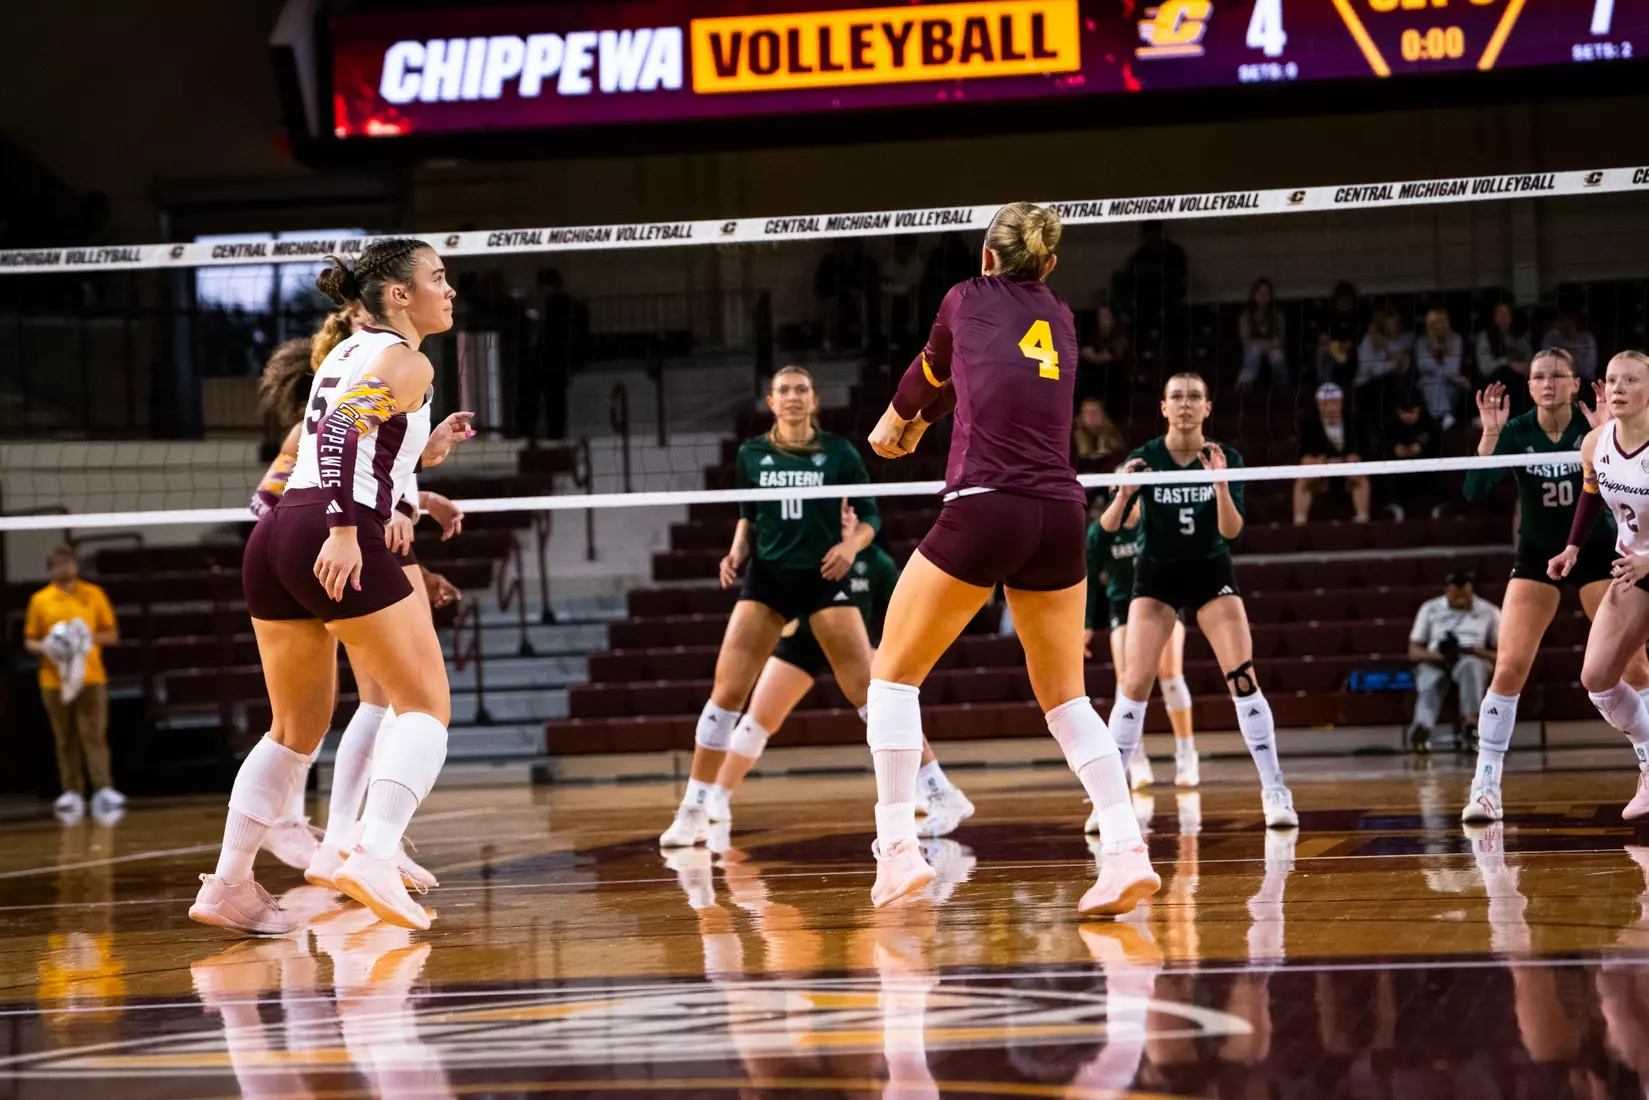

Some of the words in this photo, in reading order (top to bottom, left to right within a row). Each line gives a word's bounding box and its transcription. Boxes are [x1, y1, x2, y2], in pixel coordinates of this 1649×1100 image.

[1246, 0, 1287, 57] 4
[1401, 26, 1465, 61] 0:00
[380, 27, 683, 103] CHIPPEWA
[708, 12, 1059, 79] VOLLEYBALL
[1334, 183, 1393, 203] CENTRAL
[1397, 178, 1468, 199] MICHIGAN
[1471, 173, 1556, 194] VOLLEYBALL
[1108, 197, 1176, 216] MICHIGAN
[1179, 192, 1260, 212] VOLLEYBALL
[487, 229, 543, 247] CENTRAL
[547, 225, 611, 244] MICHIGAN
[615, 221, 693, 241] VOLLEYBALL
[763, 216, 822, 235] CENTRAL
[825, 212, 891, 232] MICHIGAN
[893, 208, 974, 228] VOLLEYBALL
[212, 243, 267, 258] CENTRAL
[272, 240, 337, 256] MICHIGAN
[1018, 320, 1060, 380] 4
[306, 377, 341, 435] 5
[320, 402, 361, 488] CHIPPEWAS
[760, 470, 825, 487] EASTERN
[1154, 486, 1216, 503] EASTERN
[1542, 480, 1574, 507] 20
[781, 498, 803, 520] 10
[1179, 507, 1196, 535] 5
